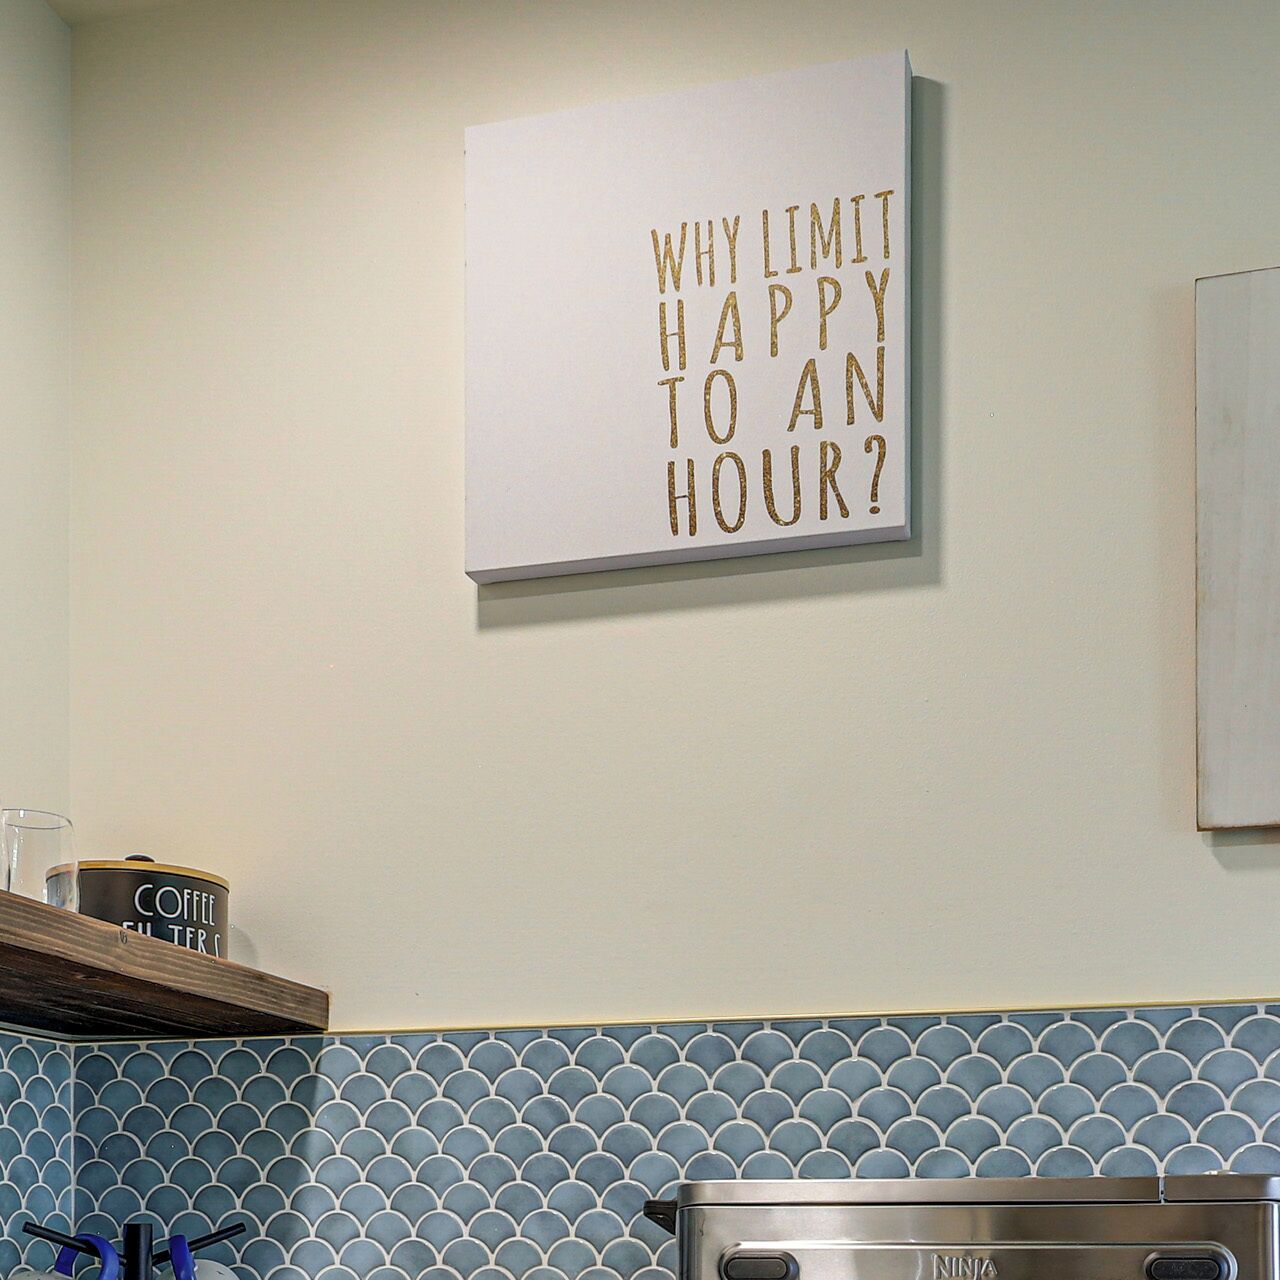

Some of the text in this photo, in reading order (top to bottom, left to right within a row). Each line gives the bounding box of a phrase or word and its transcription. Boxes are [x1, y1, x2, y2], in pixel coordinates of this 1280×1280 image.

[651, 190, 895, 294] WHY LIMIT
[659, 268, 890, 371] HAPPY
[658, 346, 885, 448] TO AN
[667, 434, 887, 536] HOUR?
[122, 922, 221, 958] TERS
[134, 884, 215, 926] COFFEE
